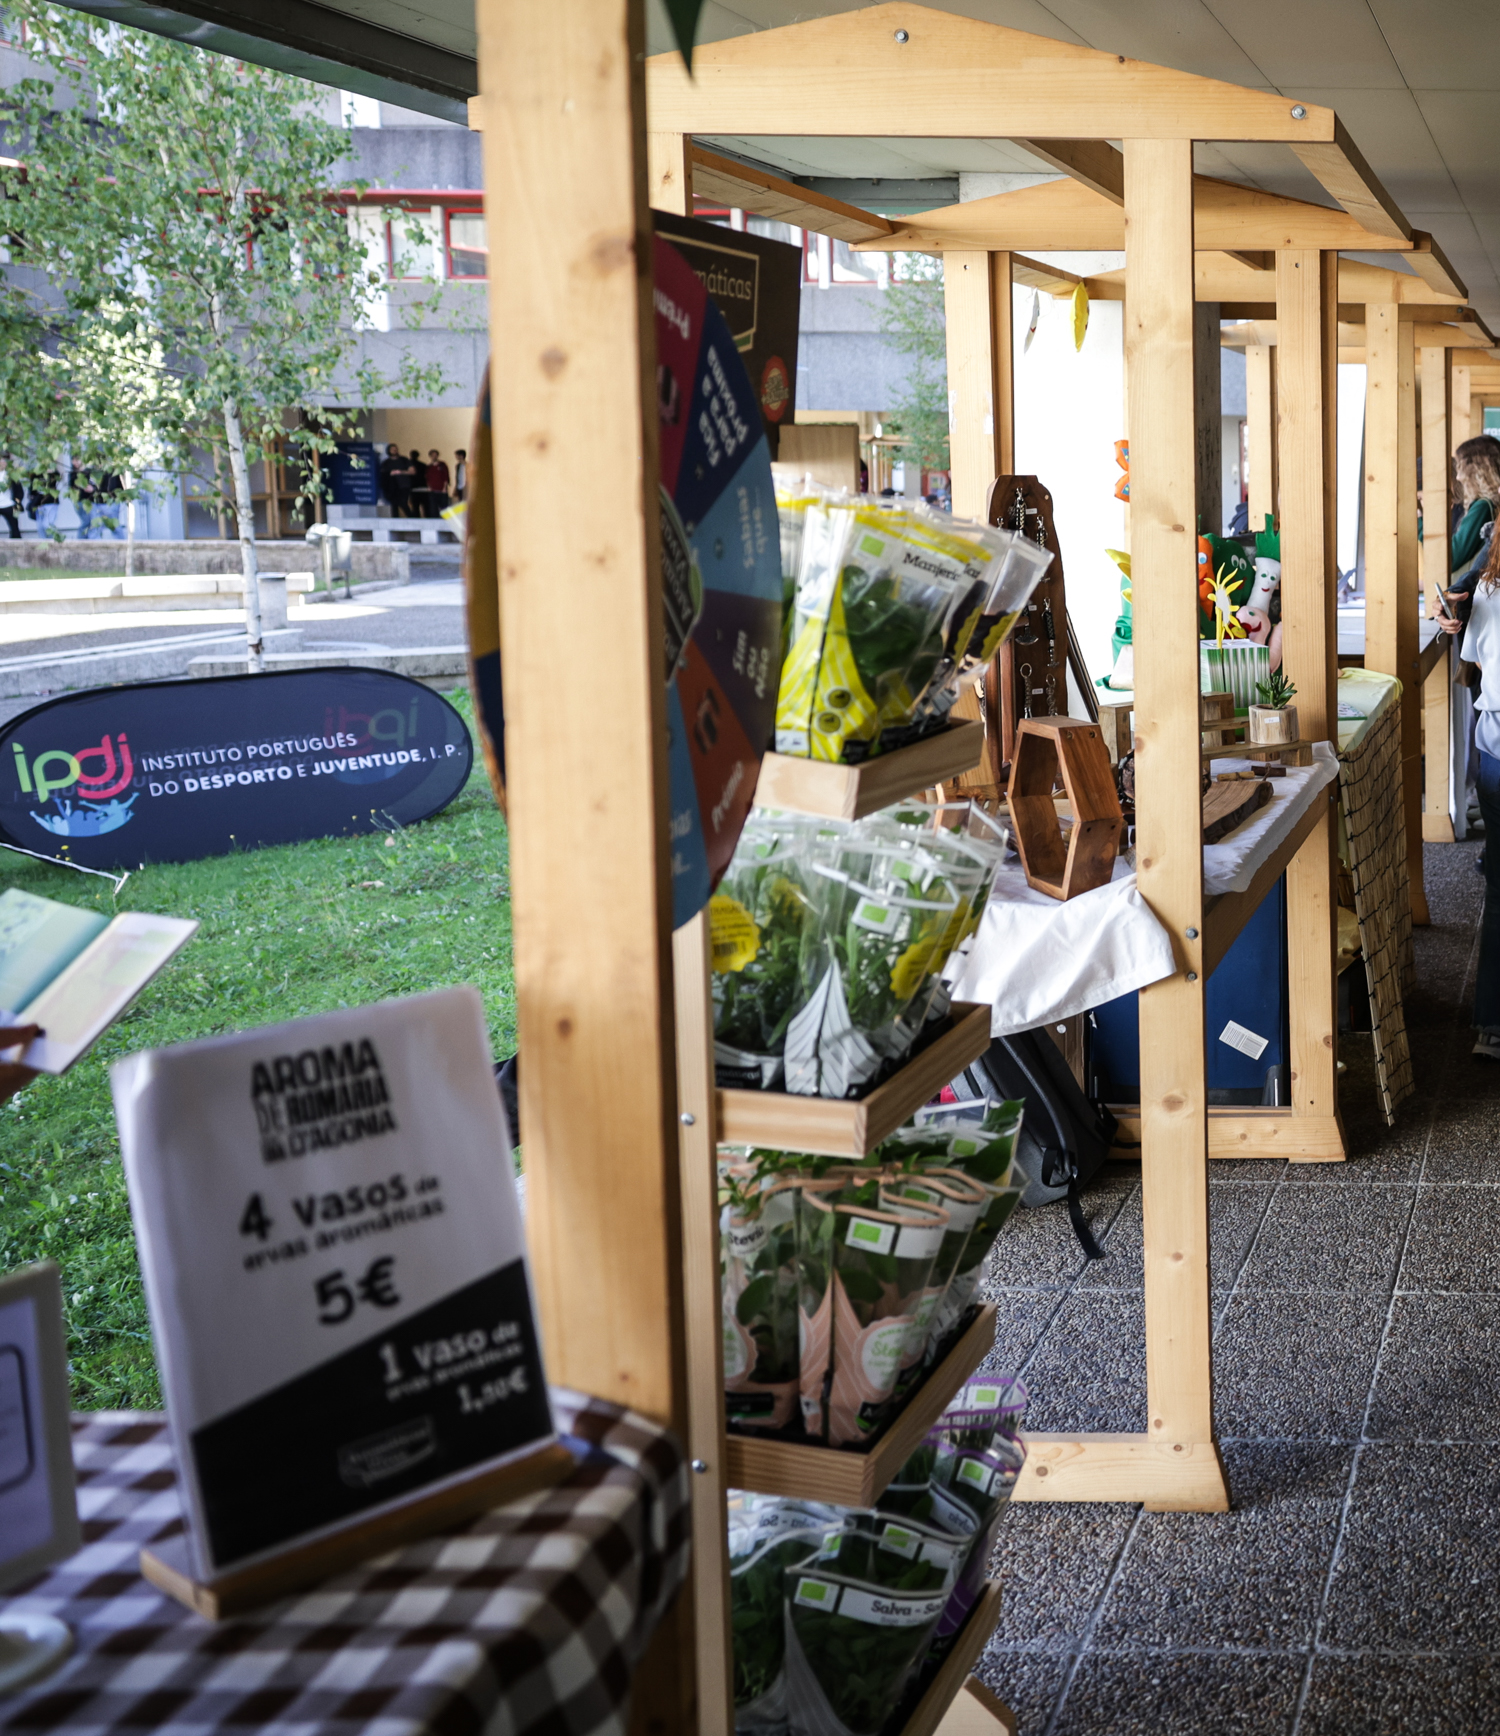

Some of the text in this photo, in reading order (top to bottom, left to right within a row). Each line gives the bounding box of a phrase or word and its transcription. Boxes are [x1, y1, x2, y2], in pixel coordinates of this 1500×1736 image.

[12, 732, 134, 803] ipdj
[142, 732, 358, 773] INSTITUTO PORTUGUÊS
[149, 780, 181, 798] DO
[184, 765, 293, 793] DESPORTO
[296, 763, 307, 778] E
[312, 748, 427, 776] JUVENTUDE,
[251, 1036, 380, 1099] AROMA
[239, 1190, 274, 1243] 4
[292, 1172, 408, 1228] vasos
[242, 1236, 309, 1273] ervas
[314, 1254, 401, 1327] 5€
[379, 1341, 402, 1384] 1
[412, 1328, 488, 1371] vaso
[871, 1599, 912, 1617] Salva
